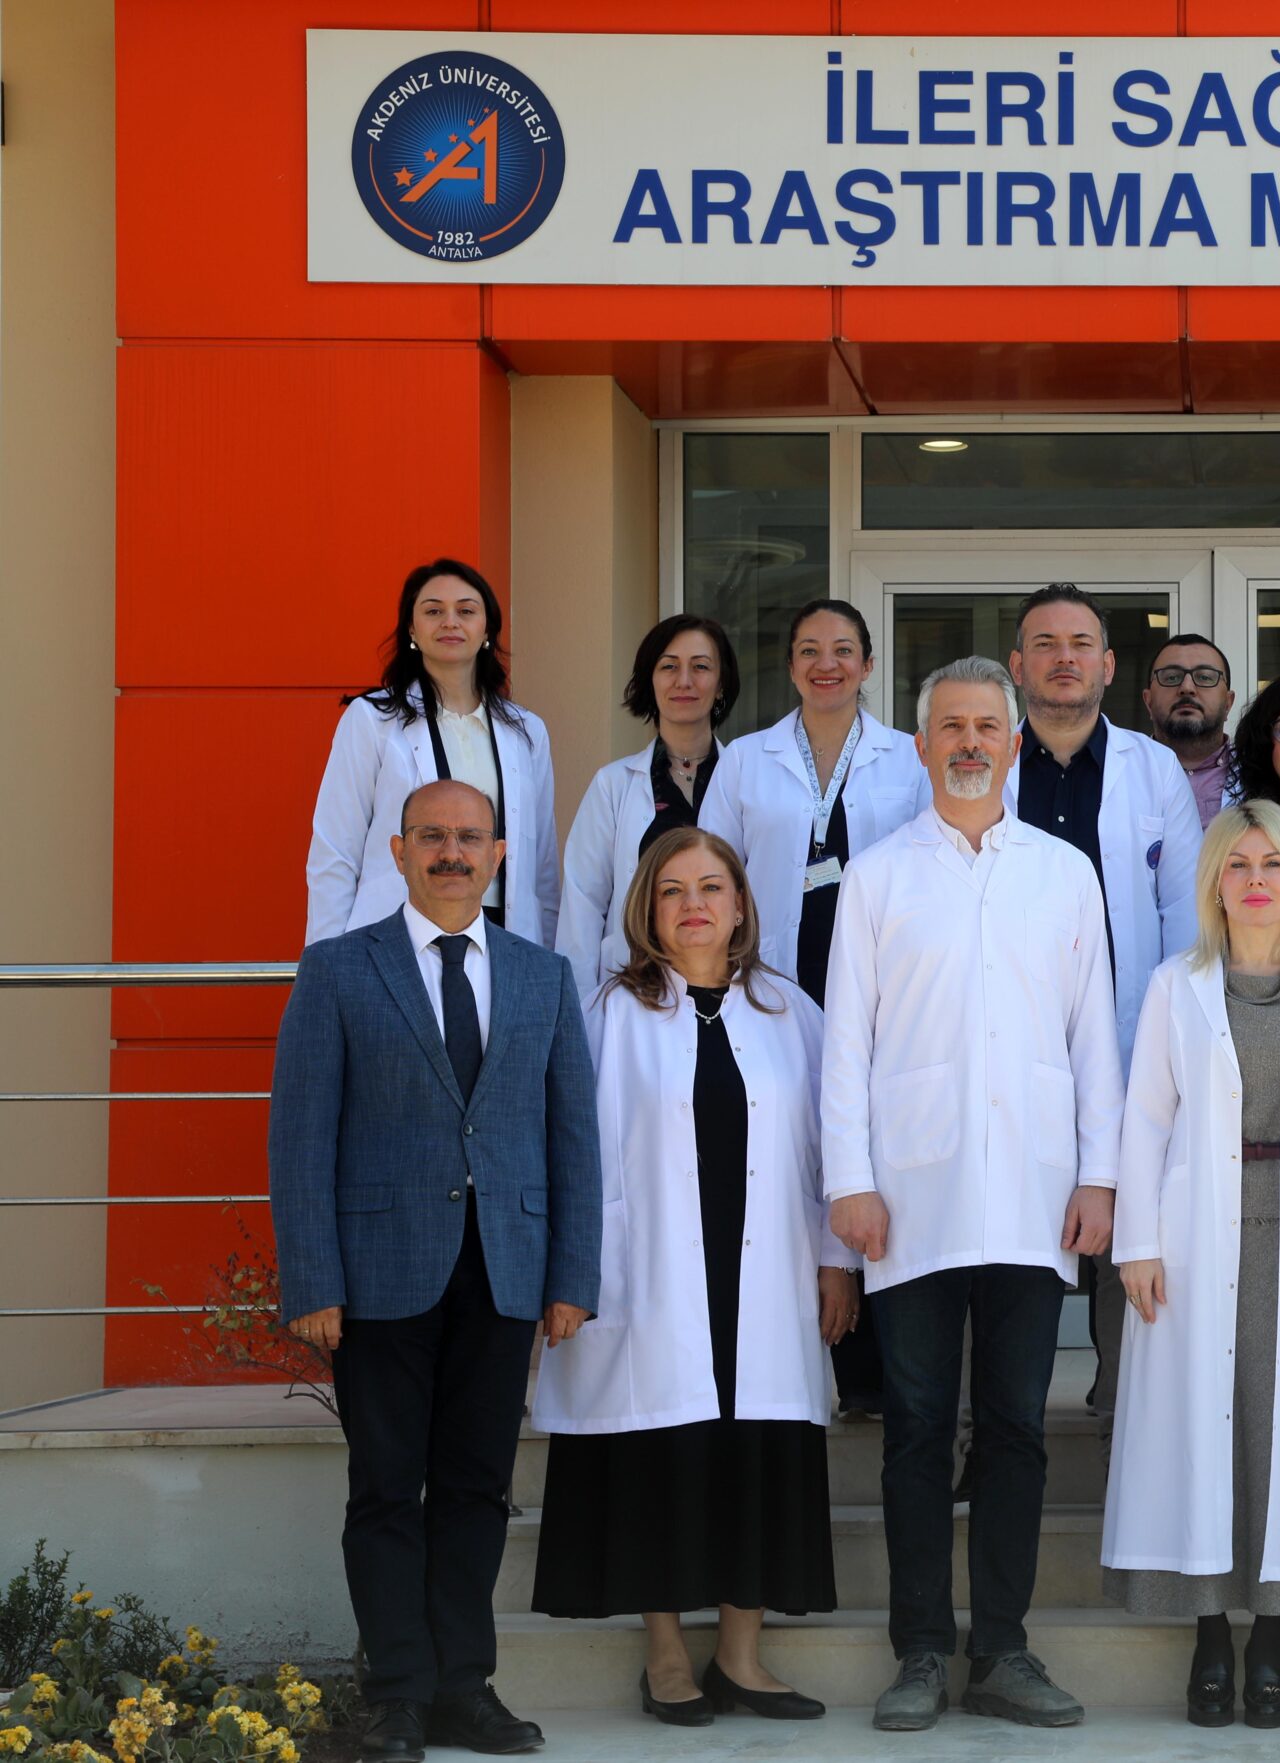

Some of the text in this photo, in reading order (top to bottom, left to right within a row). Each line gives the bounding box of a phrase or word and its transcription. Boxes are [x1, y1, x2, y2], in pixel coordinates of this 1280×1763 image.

[366, 65, 551, 144] AKDENİZ ÜNİVERSİTESİ
[827, 50, 1075, 145] İLERİ
[428, 244, 483, 259] ANTALYA
[436, 230, 475, 246] 1982
[612, 168, 1219, 268] ARAŞTIRMA
